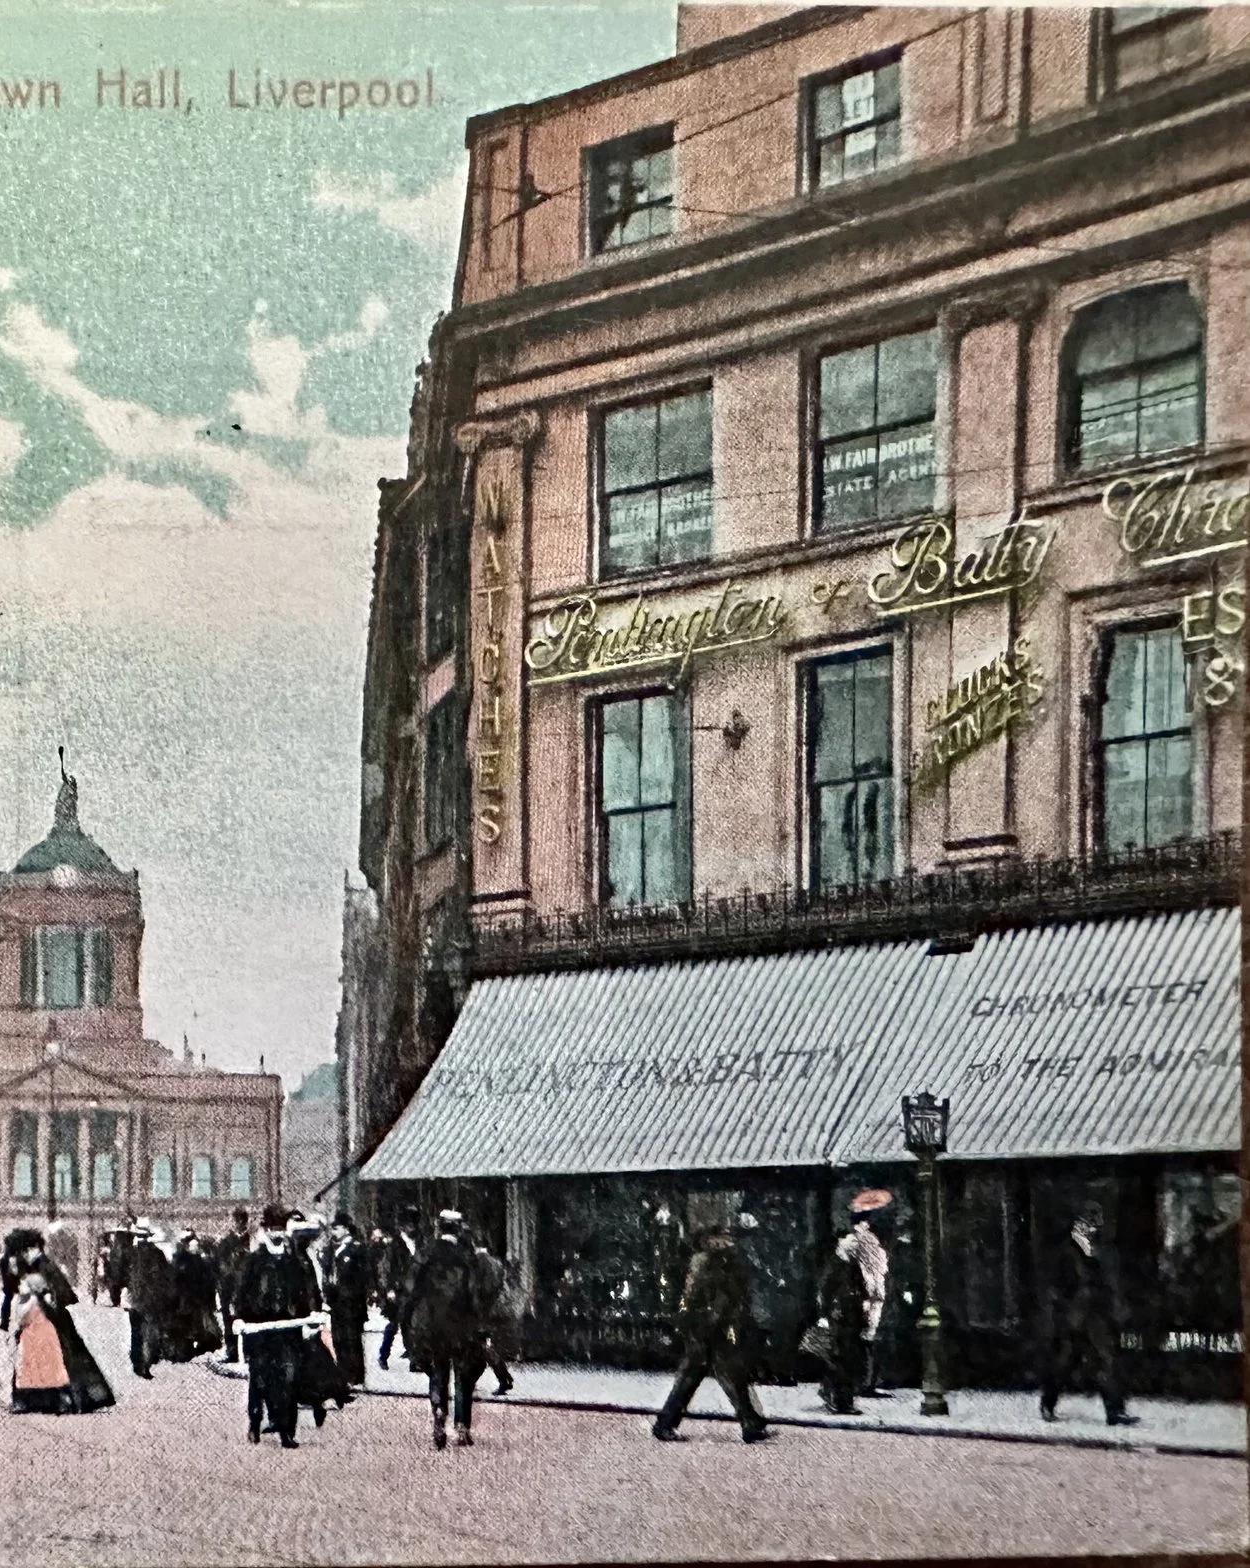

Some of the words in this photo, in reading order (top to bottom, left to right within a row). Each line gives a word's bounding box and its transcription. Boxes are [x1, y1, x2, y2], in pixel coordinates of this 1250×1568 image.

[868, 505, 1060, 603] Batty
[476, 476, 502, 843] WATCHES
[926, 634, 1031, 733] CLOCKS
[972, 978, 1208, 1018] CHRONOMETER
[1020, 1055, 1083, 1081] THE
